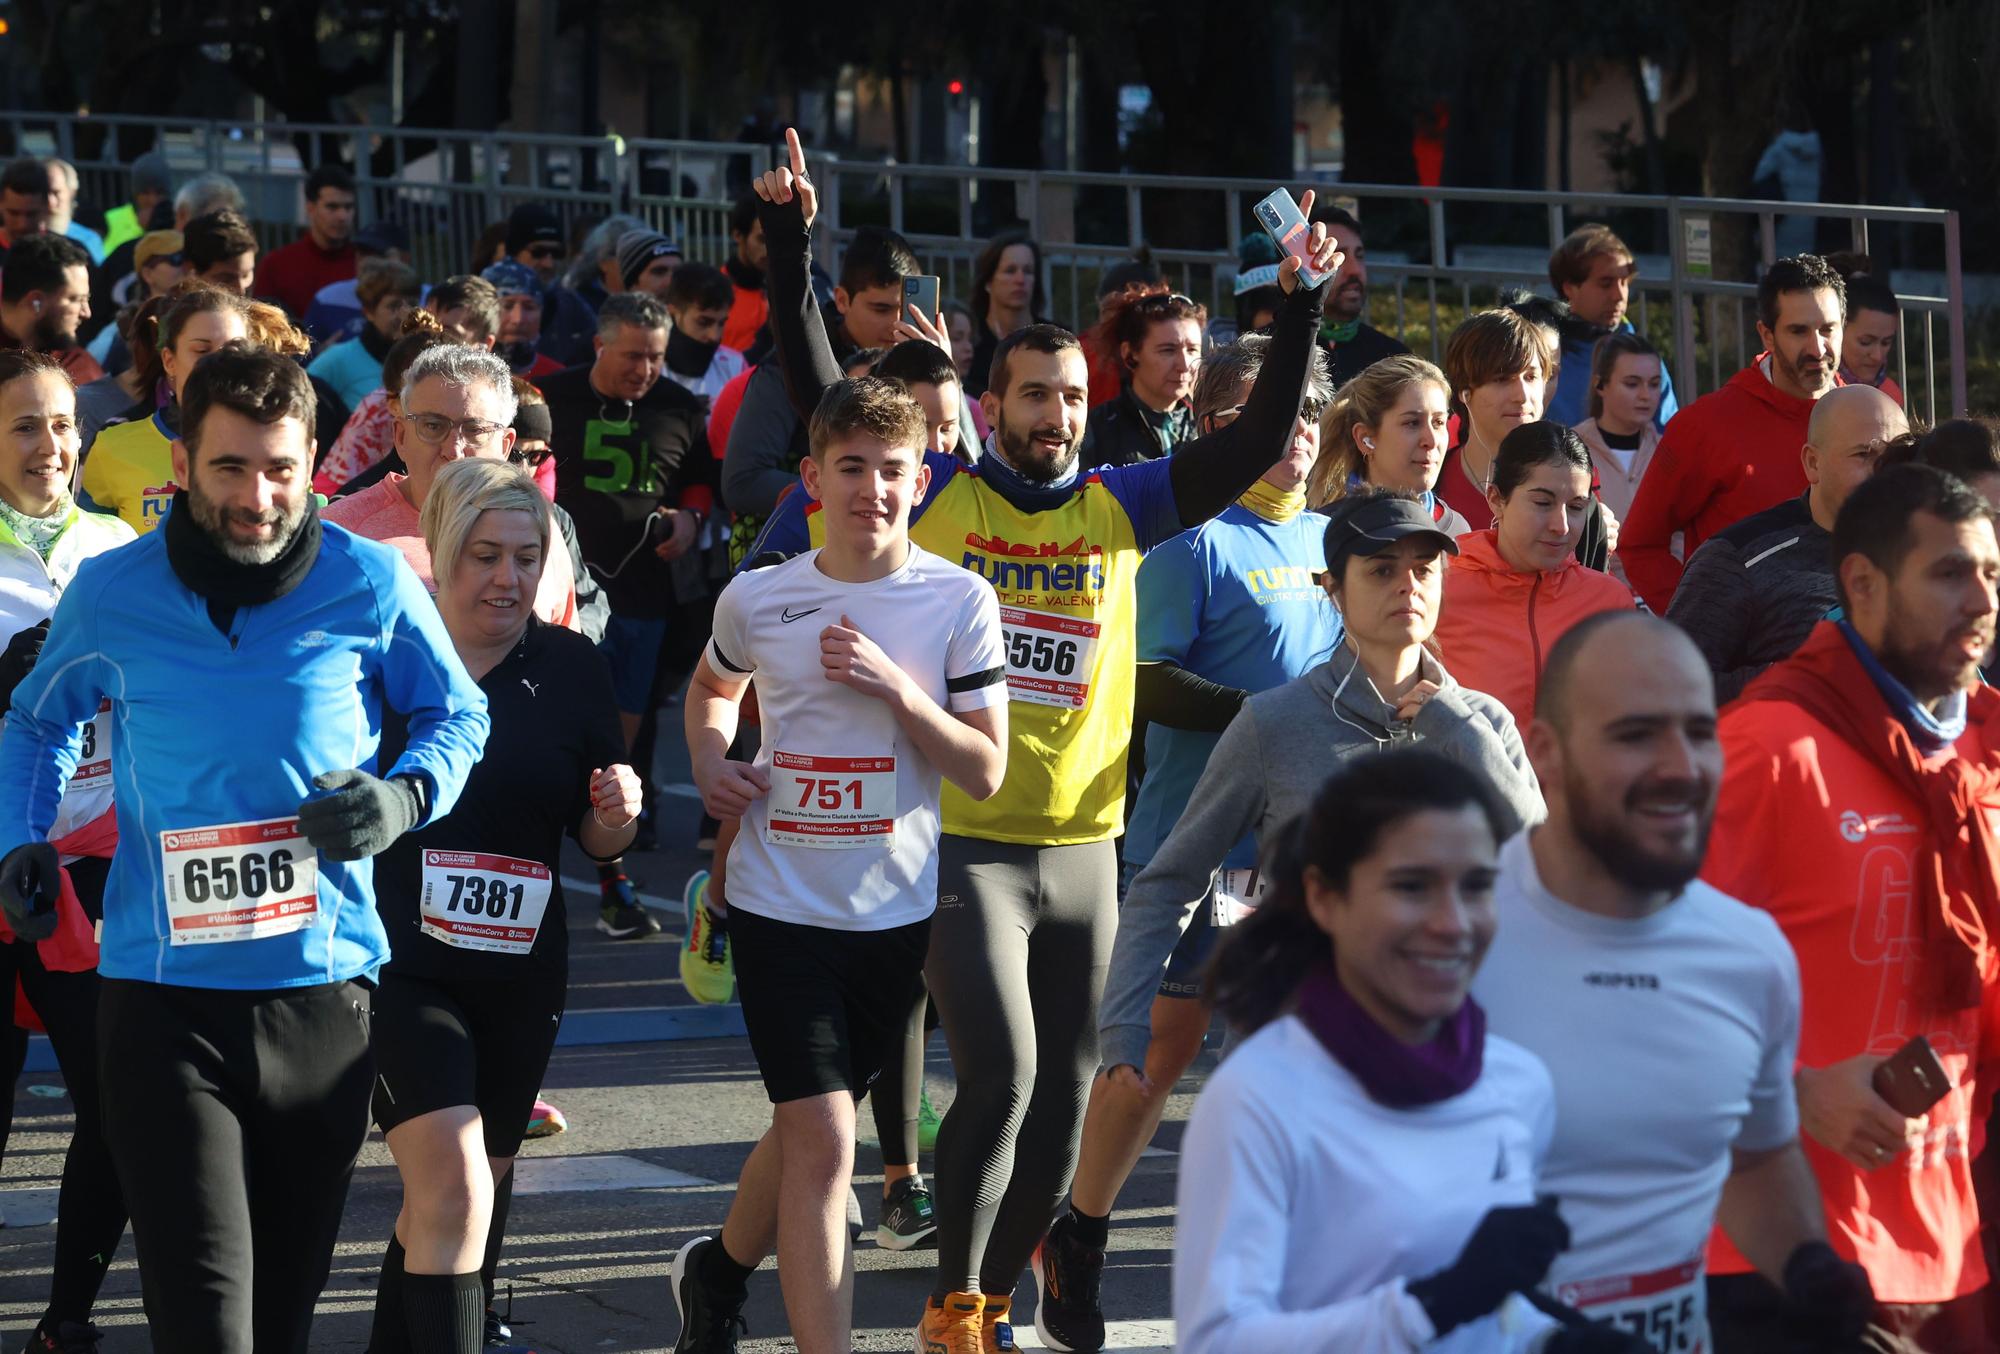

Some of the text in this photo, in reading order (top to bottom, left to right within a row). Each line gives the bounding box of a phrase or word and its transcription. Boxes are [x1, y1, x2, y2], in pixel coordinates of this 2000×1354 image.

[961, 551, 1105, 591] runners
[1016, 594, 1038, 605] DE
[795, 777, 862, 810] 751
[797, 823, 855, 833] #ValènciaCorre
[183, 849, 295, 903] 6566
[446, 875, 524, 921] 7381
[207, 908, 276, 923] #ValènciaCorre
[452, 924, 504, 936] #ValènciaCorre
